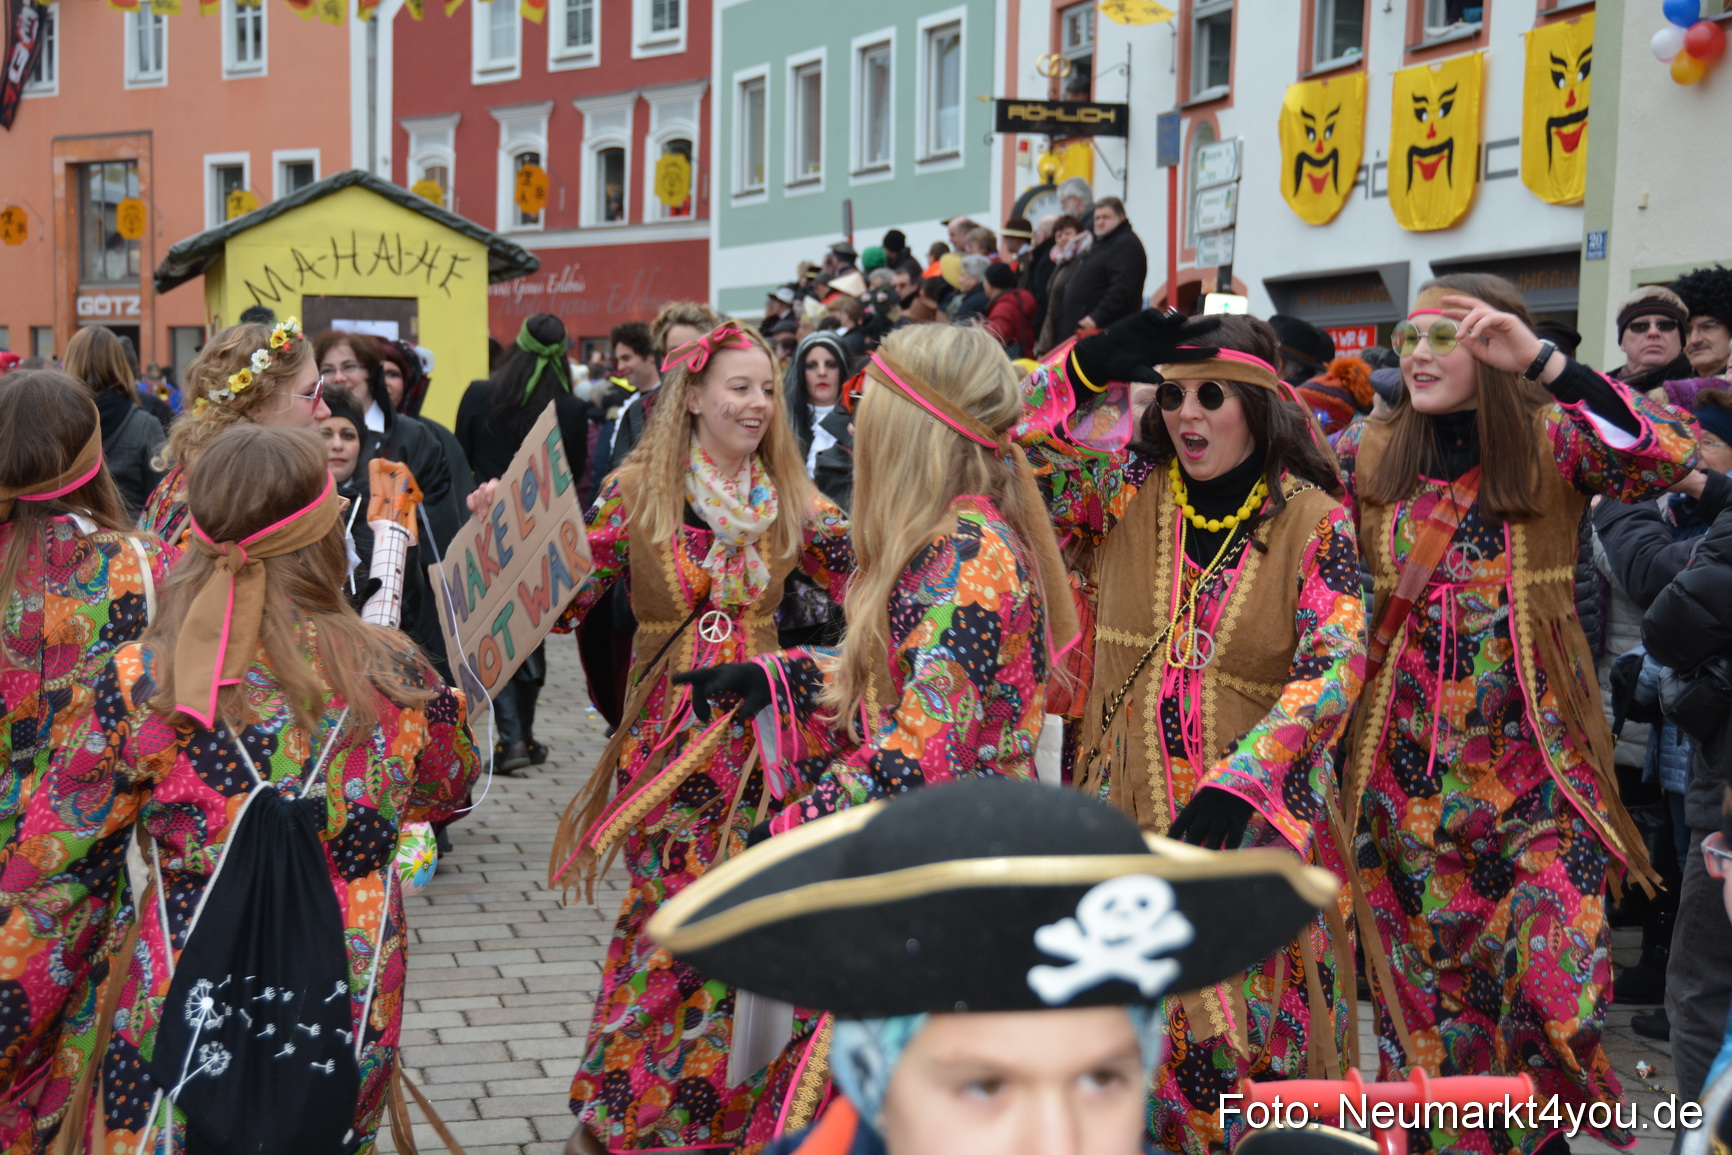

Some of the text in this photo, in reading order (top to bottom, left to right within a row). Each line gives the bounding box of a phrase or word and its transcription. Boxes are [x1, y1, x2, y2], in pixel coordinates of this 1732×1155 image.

[77, 293, 141, 316] GÖTZ
[441, 424, 570, 637] MAKE LOVE
[458, 520, 592, 715] NOT WAR
